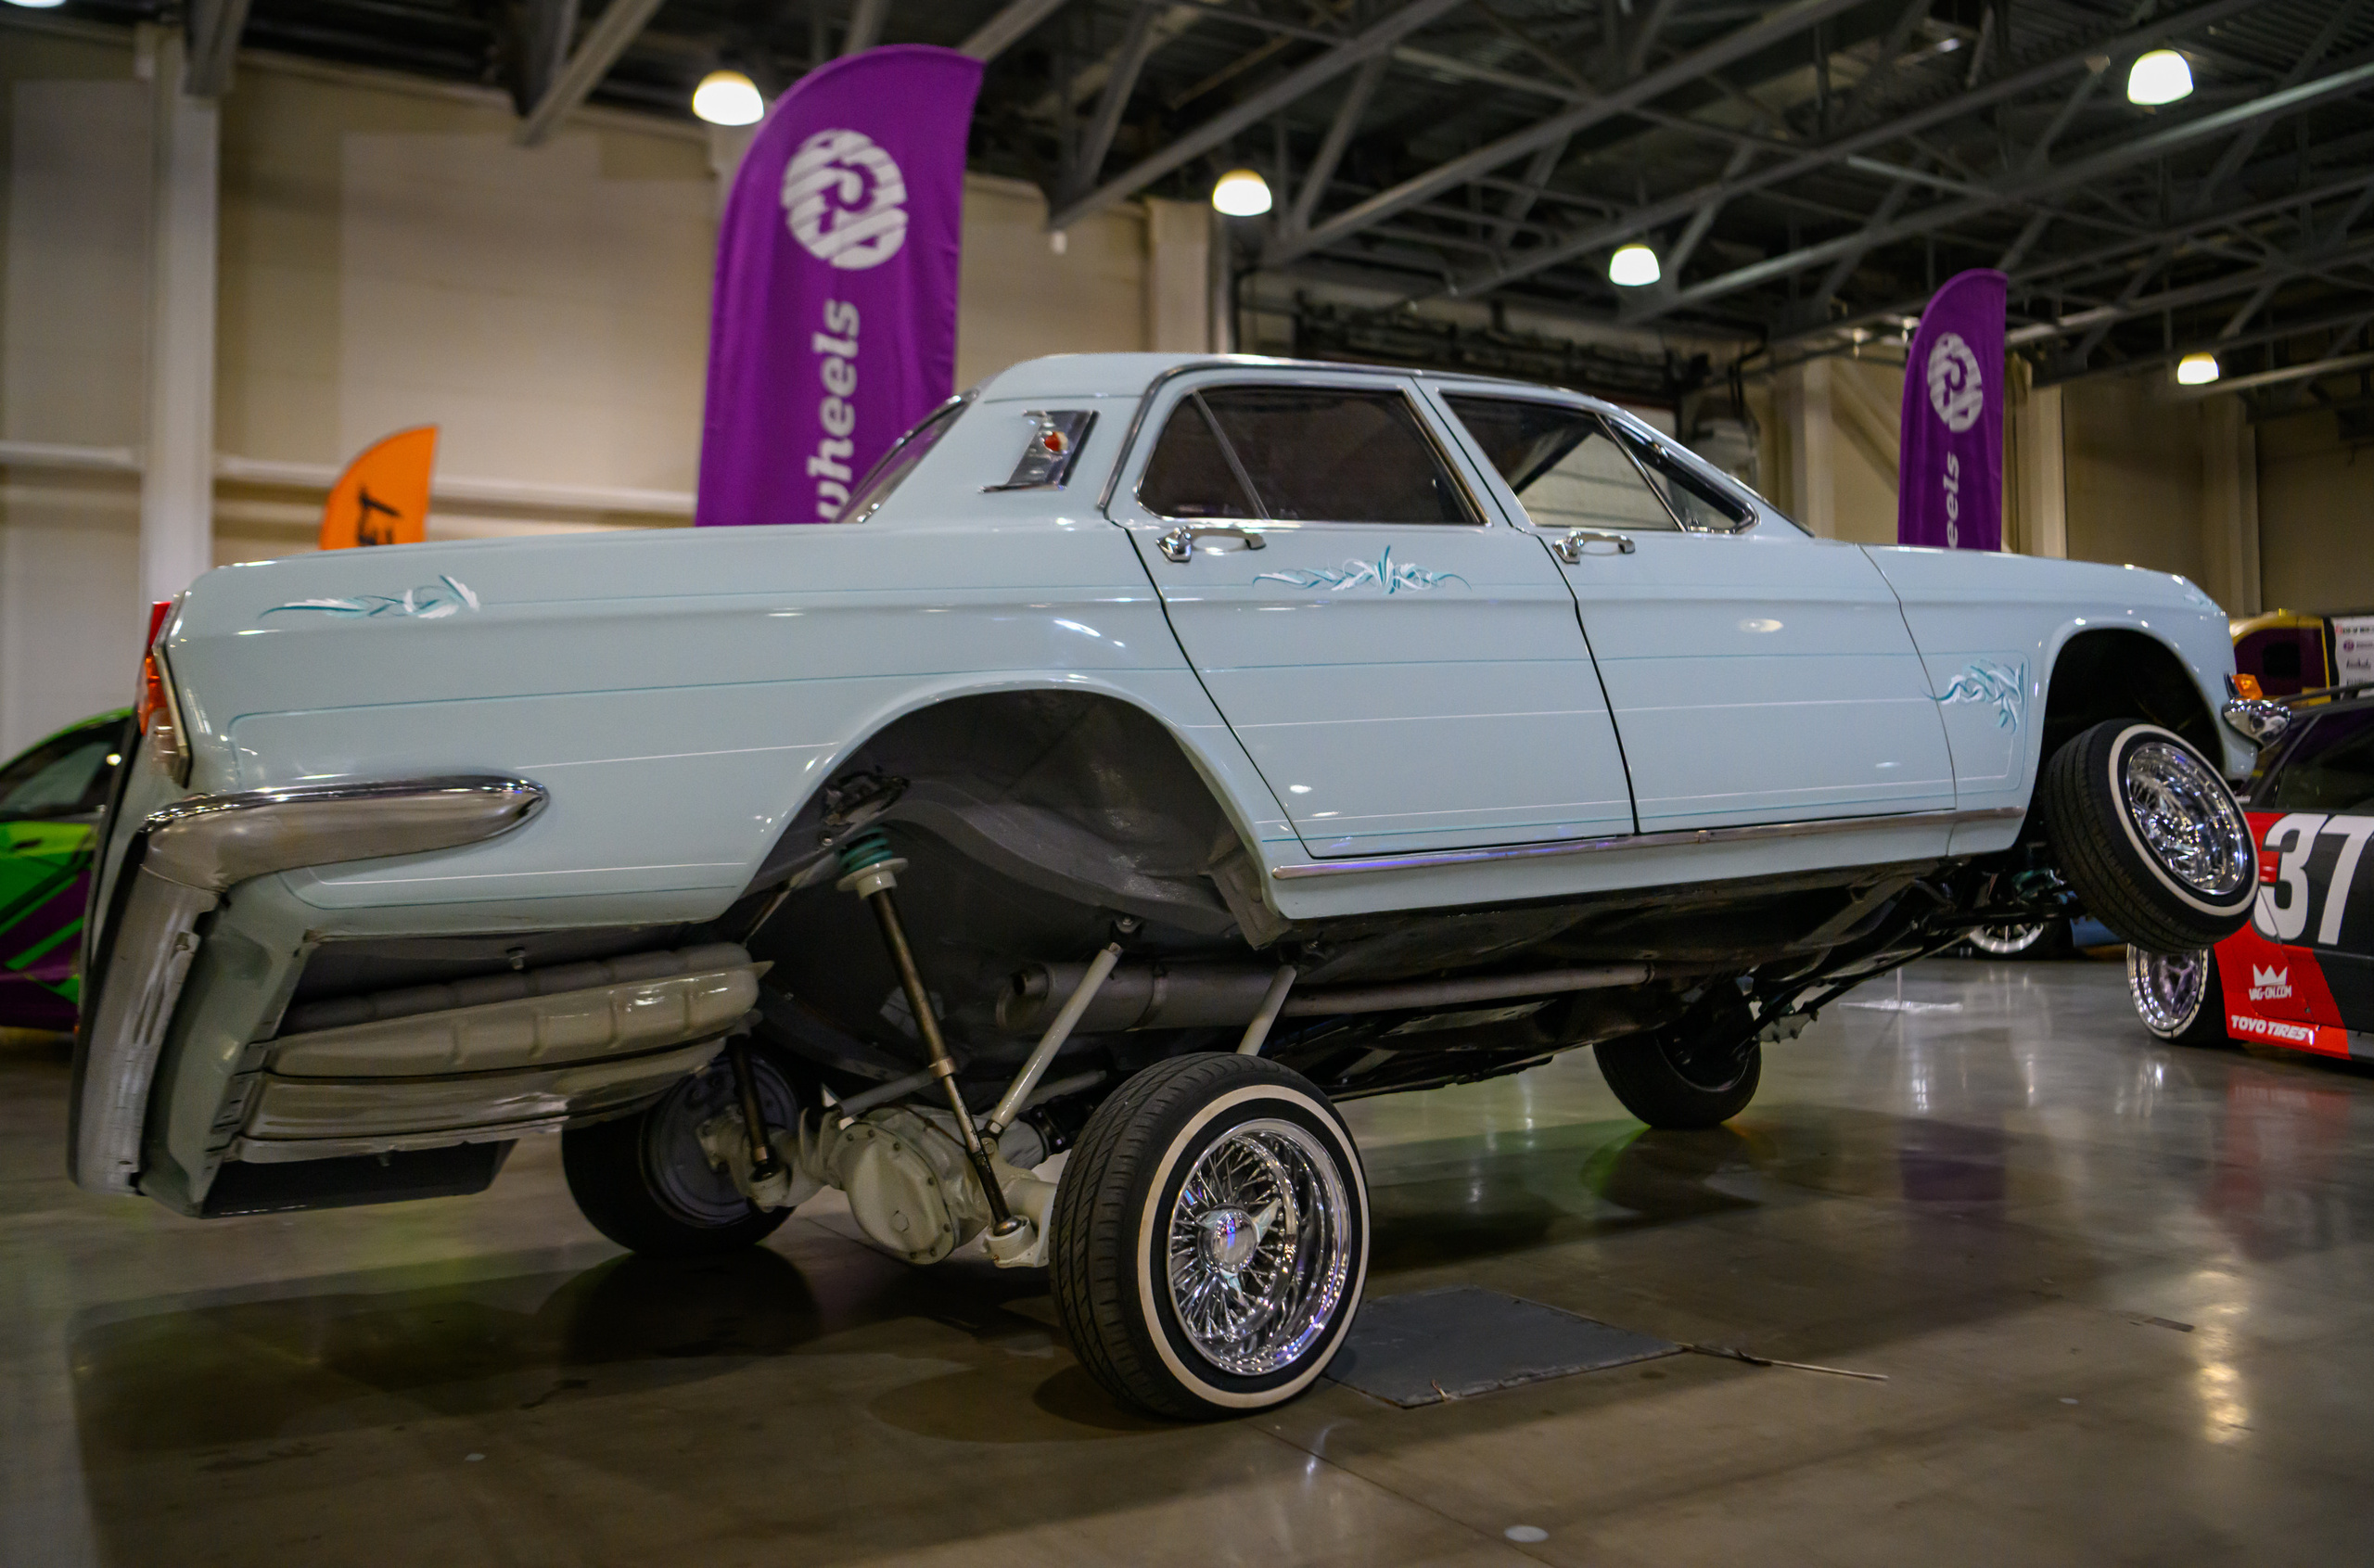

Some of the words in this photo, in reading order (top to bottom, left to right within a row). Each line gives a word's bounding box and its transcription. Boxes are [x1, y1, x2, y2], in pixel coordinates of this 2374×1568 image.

[2253, 812, 2374, 946] 37
[2231, 1014, 2267, 1034] TOYO
[2266, 1021, 2310, 1041] TIRES
